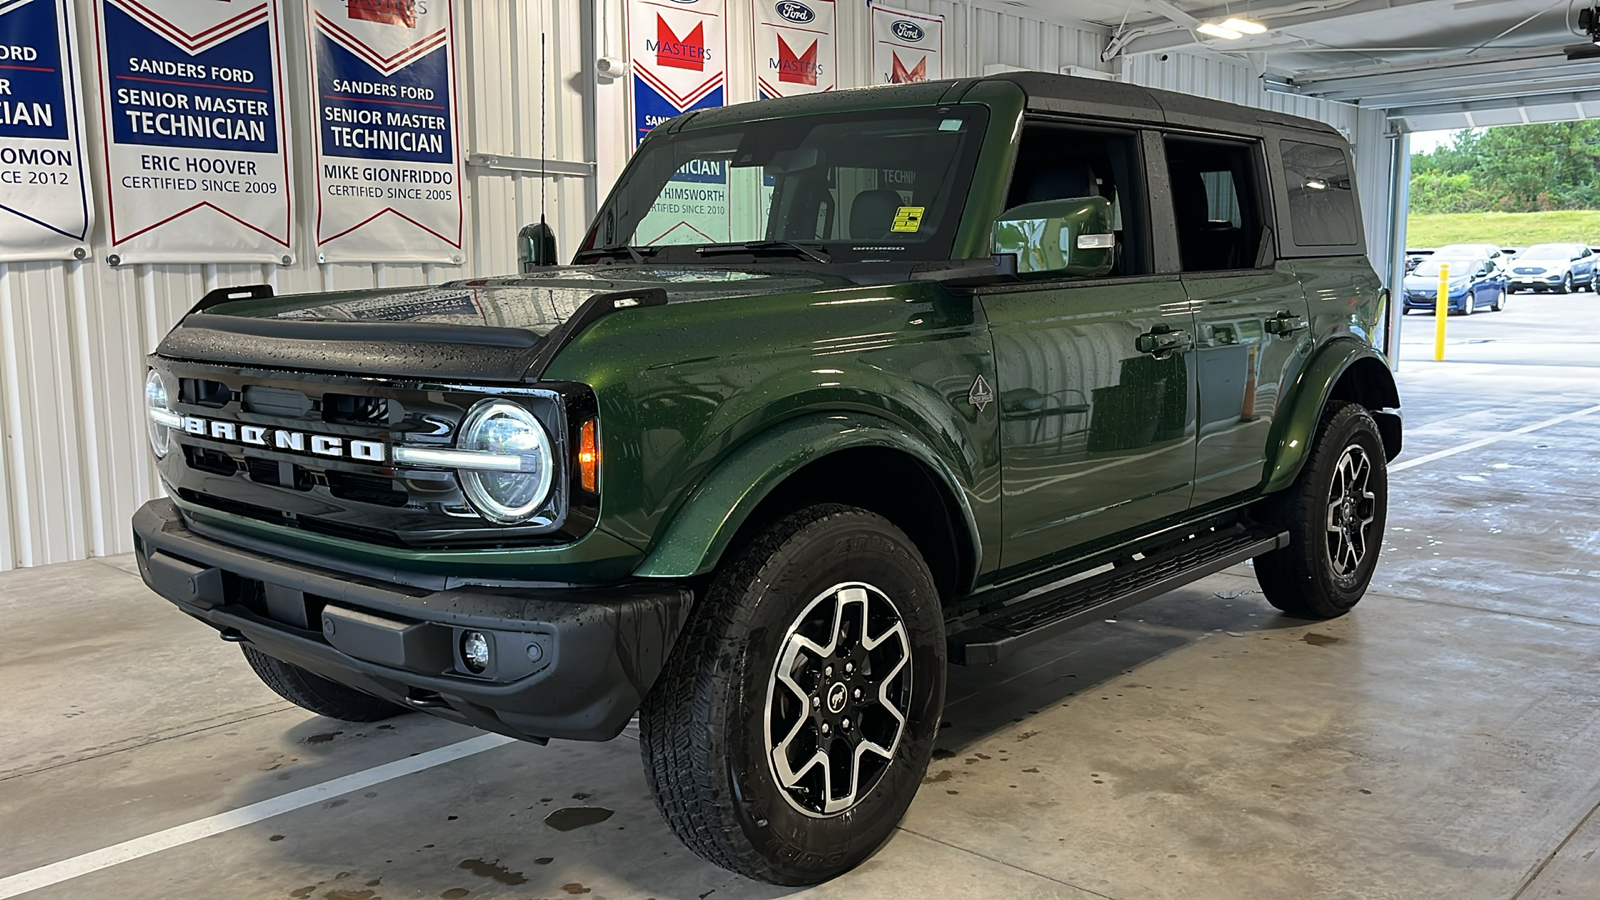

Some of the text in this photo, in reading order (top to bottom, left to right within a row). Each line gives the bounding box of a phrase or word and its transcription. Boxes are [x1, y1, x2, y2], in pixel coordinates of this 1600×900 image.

[341, 0, 427, 14] STERS
[781, 2, 809, 21] Ford
[897, 22, 920, 40] Ford
[0, 45, 38, 61] ORD
[646, 39, 712, 60] MASTERS
[129, 57, 254, 83] SANDERS FORD
[769, 57, 824, 75] MASTERS
[333, 79, 434, 100] SANDERS FORD
[117, 88, 269, 116] SENIOR MASTER
[126, 110, 266, 142] TECHNICIAN
[325, 106, 446, 130] SENIOR MASTER
[330, 126, 443, 153] TECHNICIAN
[0, 147, 72, 166] OMON
[141, 154, 257, 176] ERIC HOOVER
[1, 171, 69, 185] CE 2012
[324, 164, 453, 185] MIKE GIONFRIDDO
[882, 169, 916, 184] TECHNI
[121, 176, 277, 194] CERTIFIED SINCE 2009
[328, 184, 452, 200] CERTIFIED SINCE 2005
[664, 188, 725, 202] HIMSWORTH
[682, 204, 704, 214] SINCE
[707, 205, 725, 215] 2010
[185, 416, 386, 462] BRONCO
